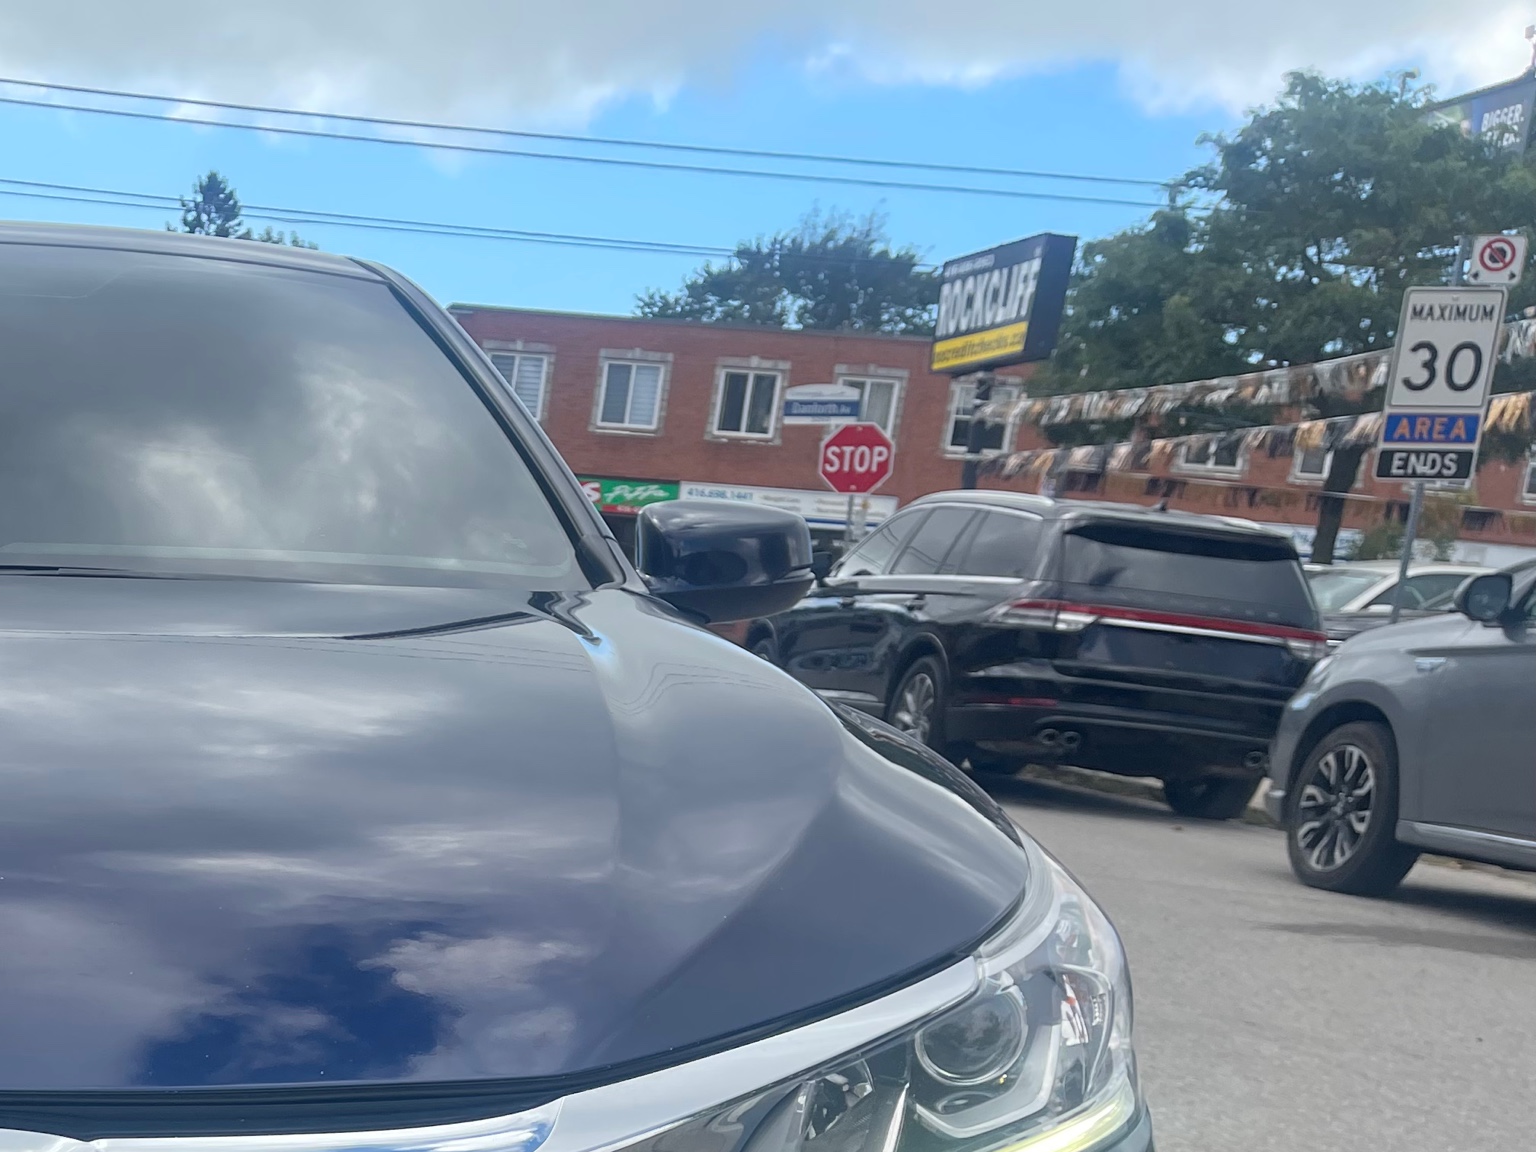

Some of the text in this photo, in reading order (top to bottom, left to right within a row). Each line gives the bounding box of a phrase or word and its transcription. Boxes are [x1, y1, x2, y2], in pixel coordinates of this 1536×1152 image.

[935, 257, 1043, 338] ROCKCLIFF
[1410, 304, 1494, 322] MAXIMUM
[1402, 341, 1482, 391] 30
[1394, 417, 1466, 440] AREA
[825, 446, 888, 473] STOP
[1390, 453, 1457, 477] ENDS
